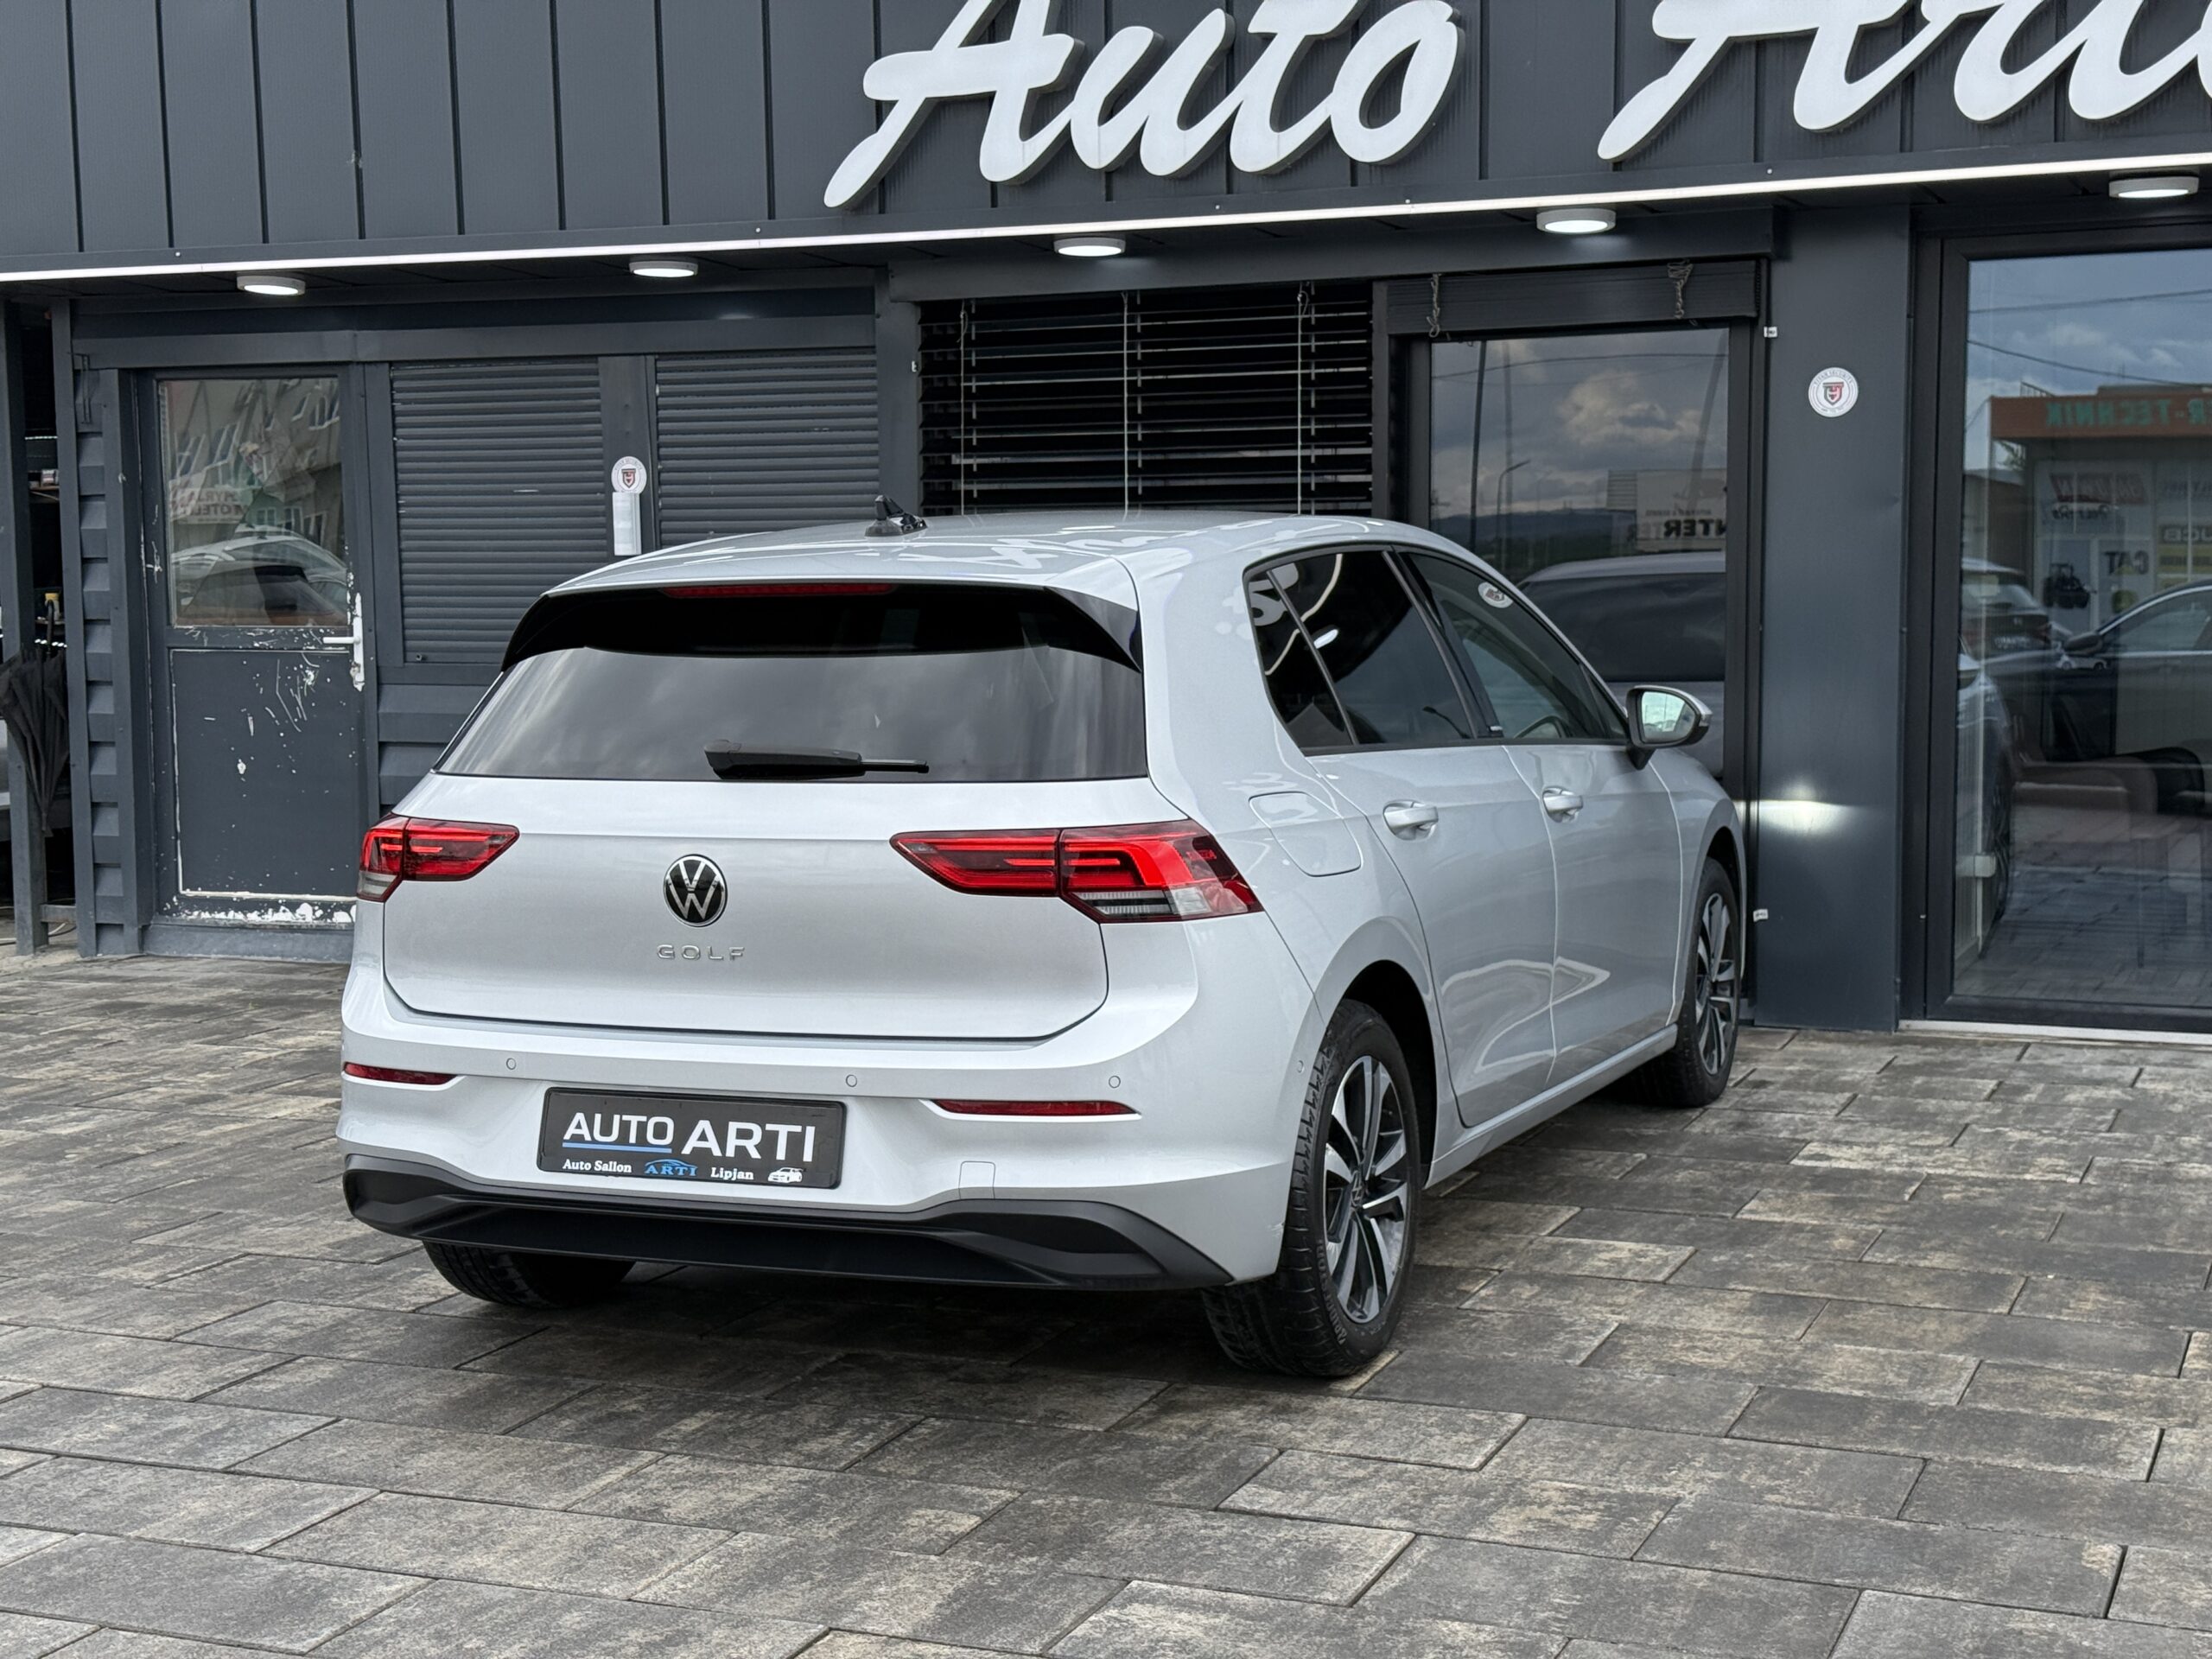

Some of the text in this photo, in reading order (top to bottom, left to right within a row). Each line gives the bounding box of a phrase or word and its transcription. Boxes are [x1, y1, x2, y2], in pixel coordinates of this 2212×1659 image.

[823, 0, 1459, 208] Auto
[658, 944, 744, 960] GOLF
[563, 1112, 816, 1162] AUTO ARTI
[563, 1159, 591, 1171] Auto
[645, 1166, 698, 1177] ARTI
[710, 1166, 753, 1181] Lipjan
